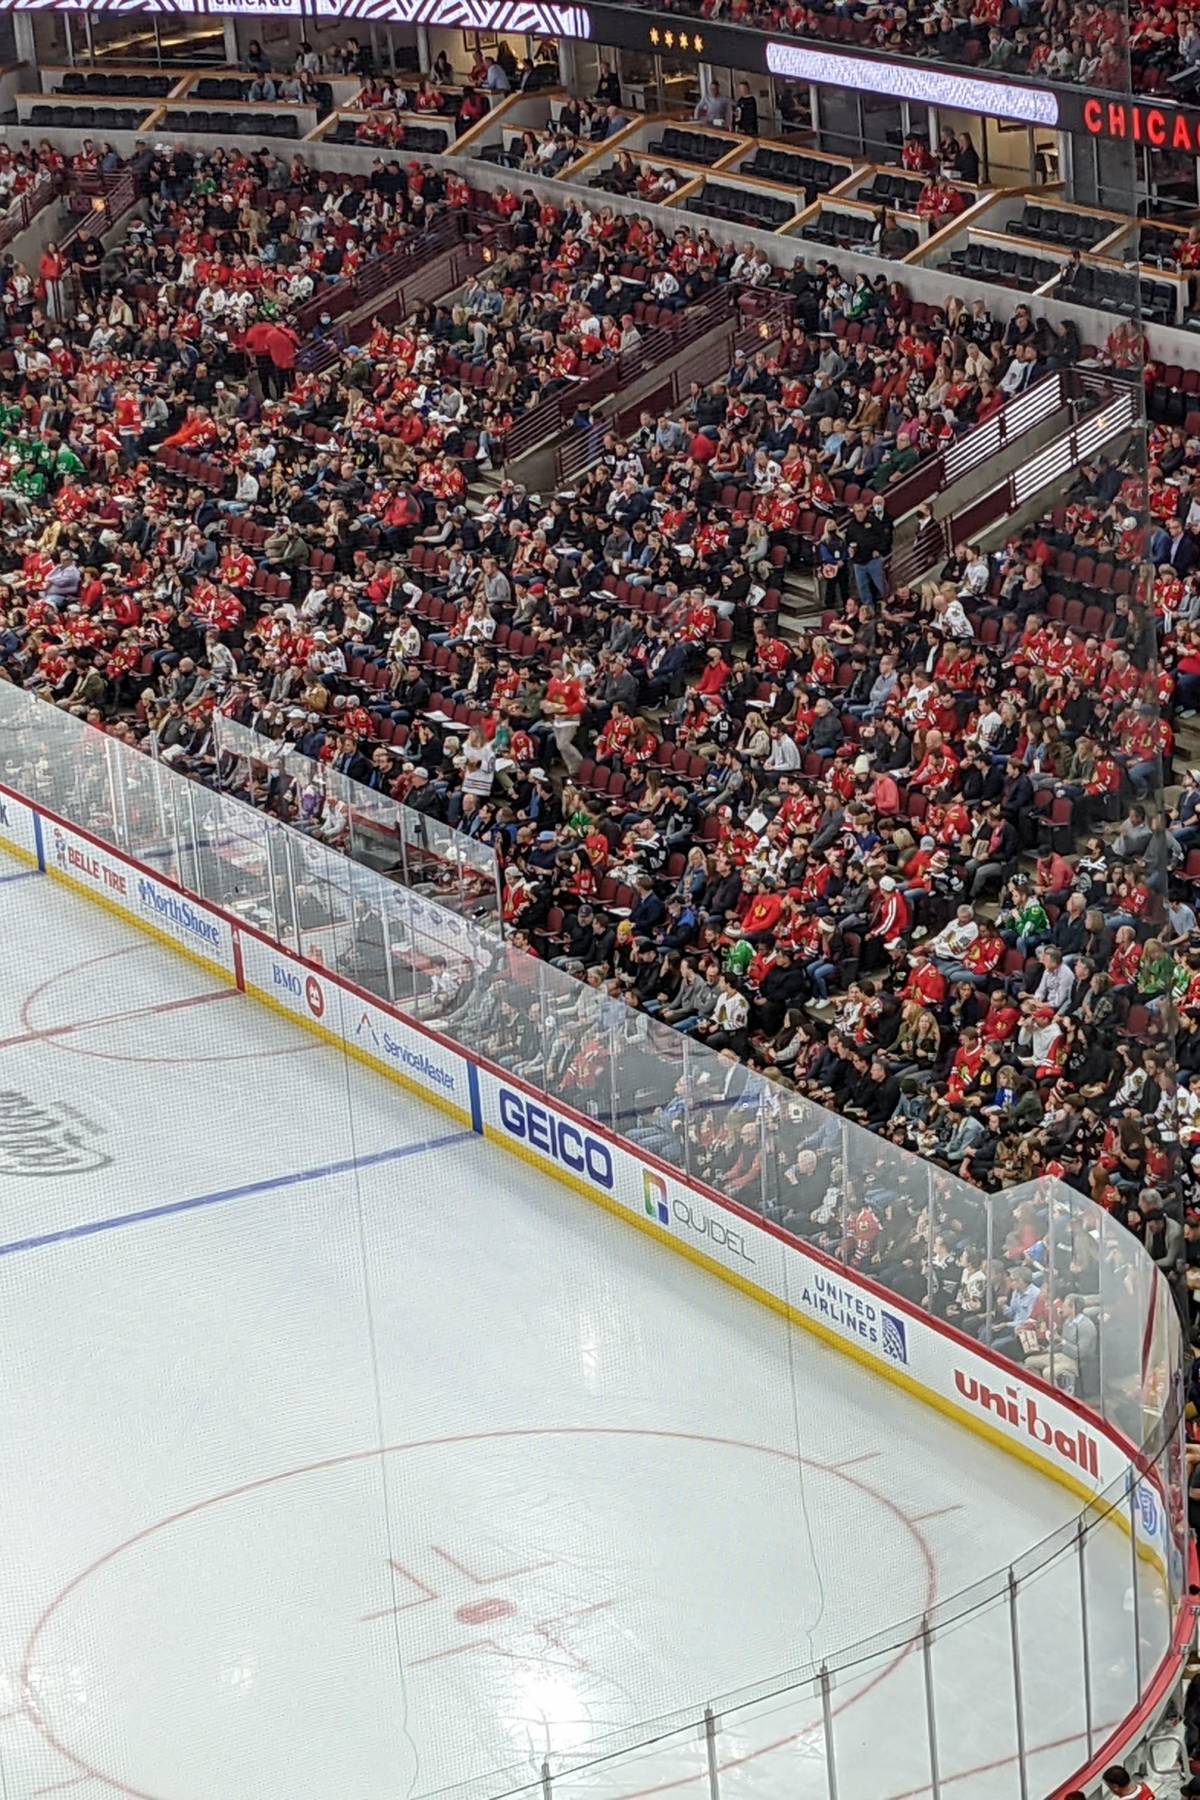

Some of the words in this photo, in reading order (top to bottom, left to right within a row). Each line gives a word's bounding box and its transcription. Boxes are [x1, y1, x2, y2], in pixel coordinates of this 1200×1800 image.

[67, 846, 100, 879] BELLE
[101, 865, 127, 895] TIRE
[147, 880, 220, 945] NorthShore
[272, 963, 302, 996] BMO
[383, 1032, 455, 1091] ServiceMaster
[498, 1088, 614, 1190] GEICO
[672, 1199, 756, 1265] QUIDEL
[801, 1288, 878, 1344] AIRLINES
[814, 1274, 877, 1322] UNITED
